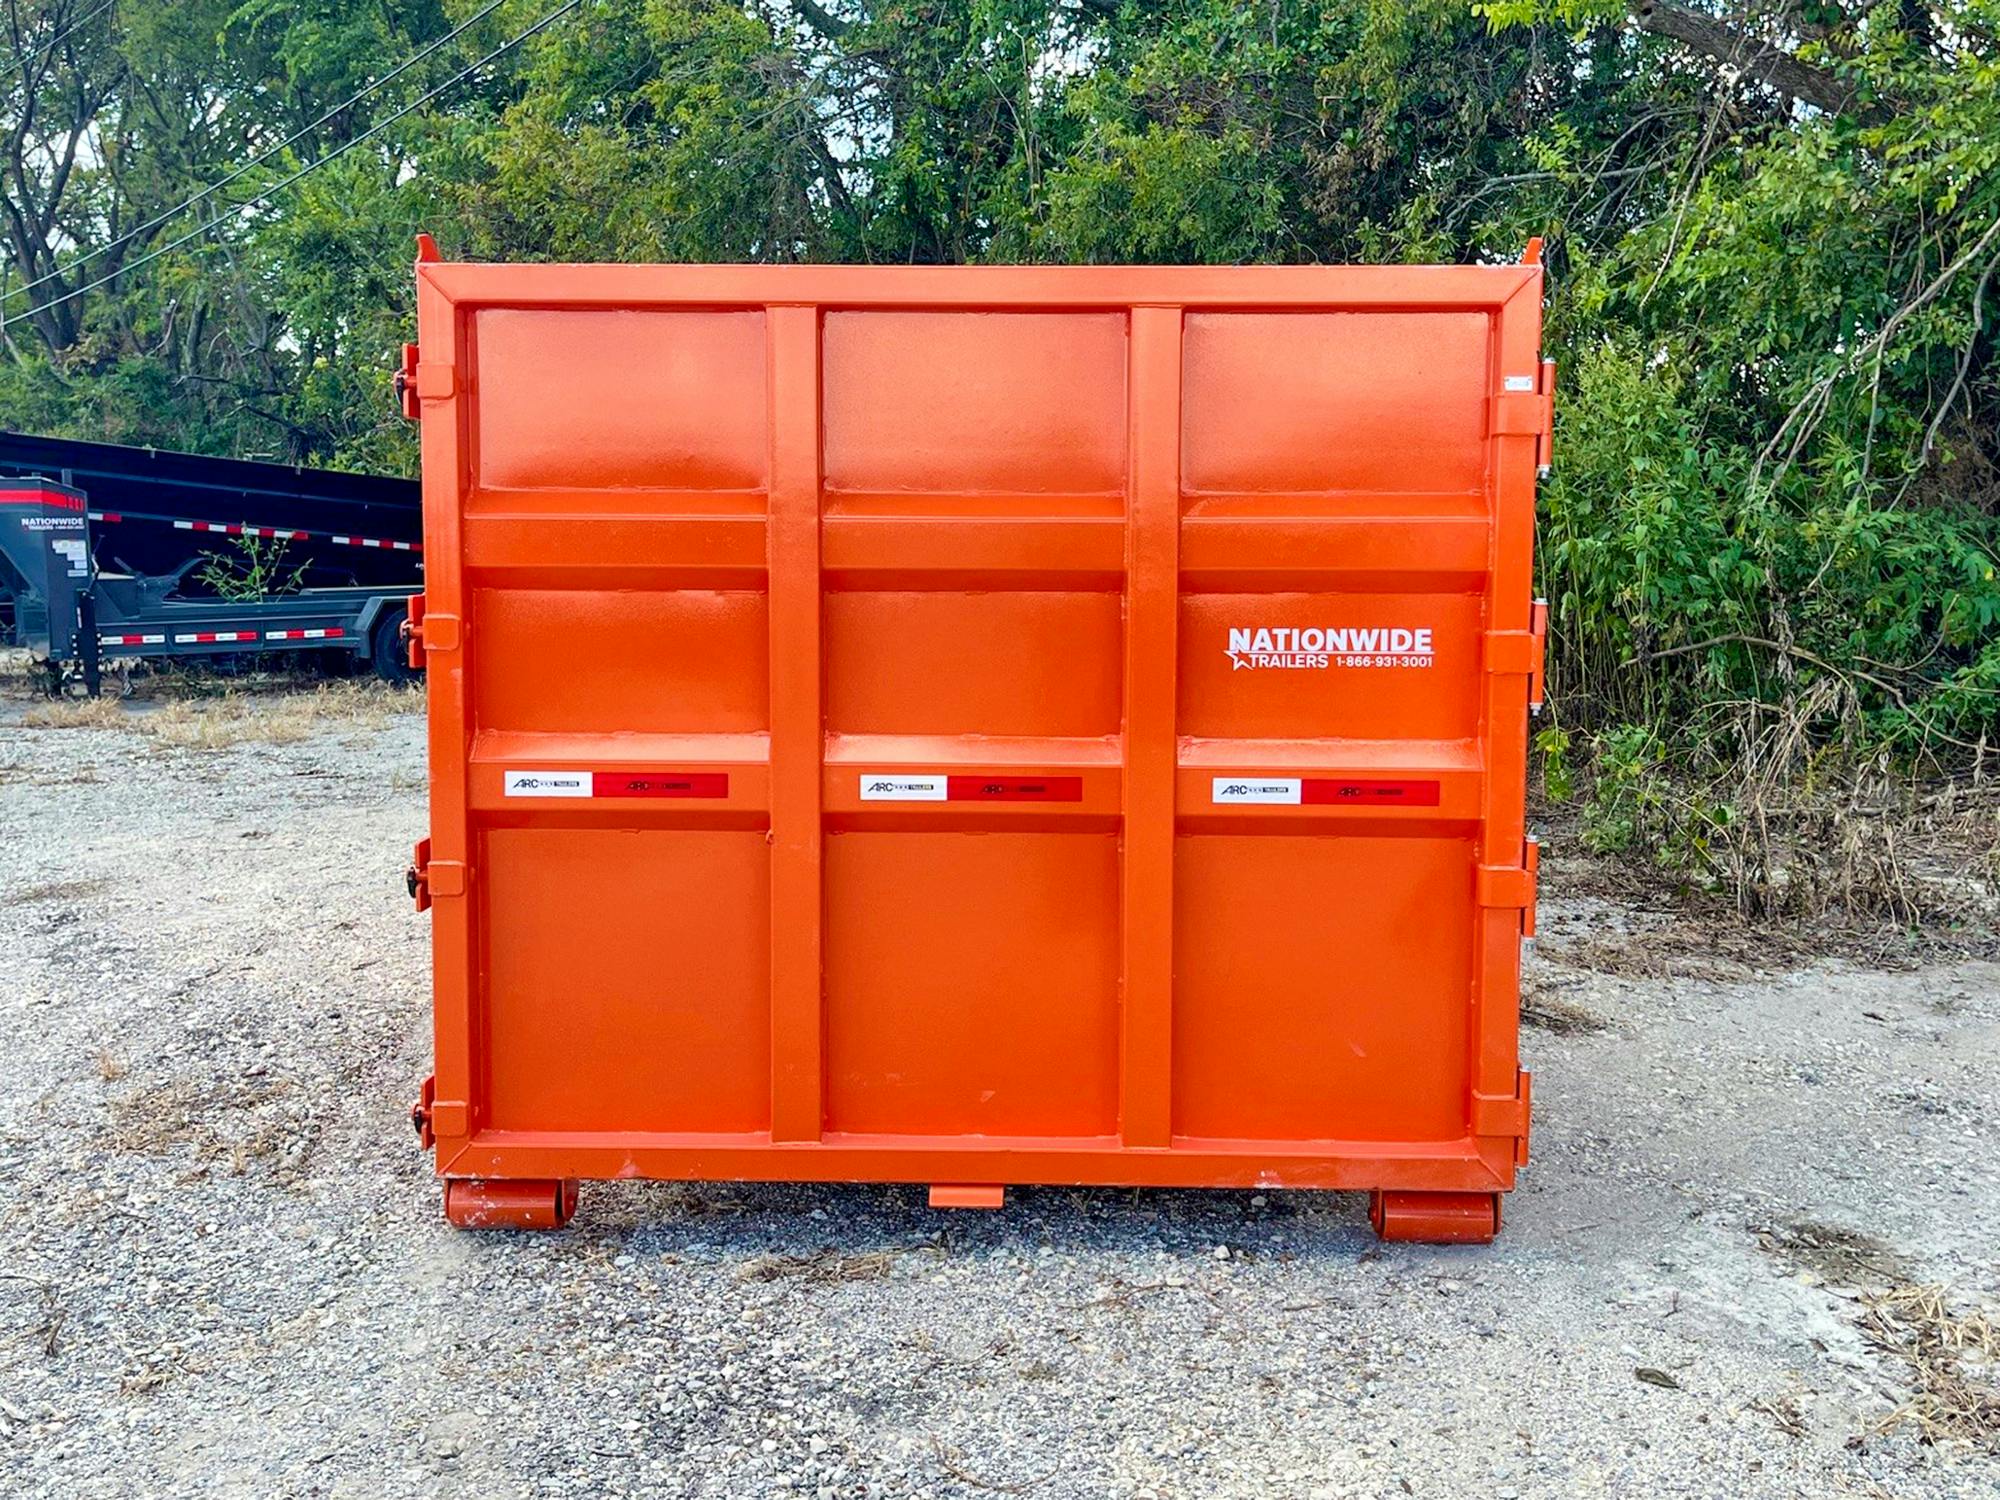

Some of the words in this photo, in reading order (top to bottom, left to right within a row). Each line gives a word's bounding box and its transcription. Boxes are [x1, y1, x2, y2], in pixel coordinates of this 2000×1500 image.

[21, 517, 84, 526] NATIONWIDE
[1229, 628, 1432, 651] NATIONWIDE
[1249, 654, 1329, 668] TRAILERS
[1336, 656, 1433, 668] 1-866-931-3001
[512, 779, 539, 789] ARC
[867, 782, 894, 793] ARC
[1220, 785, 1248, 796] ARC
